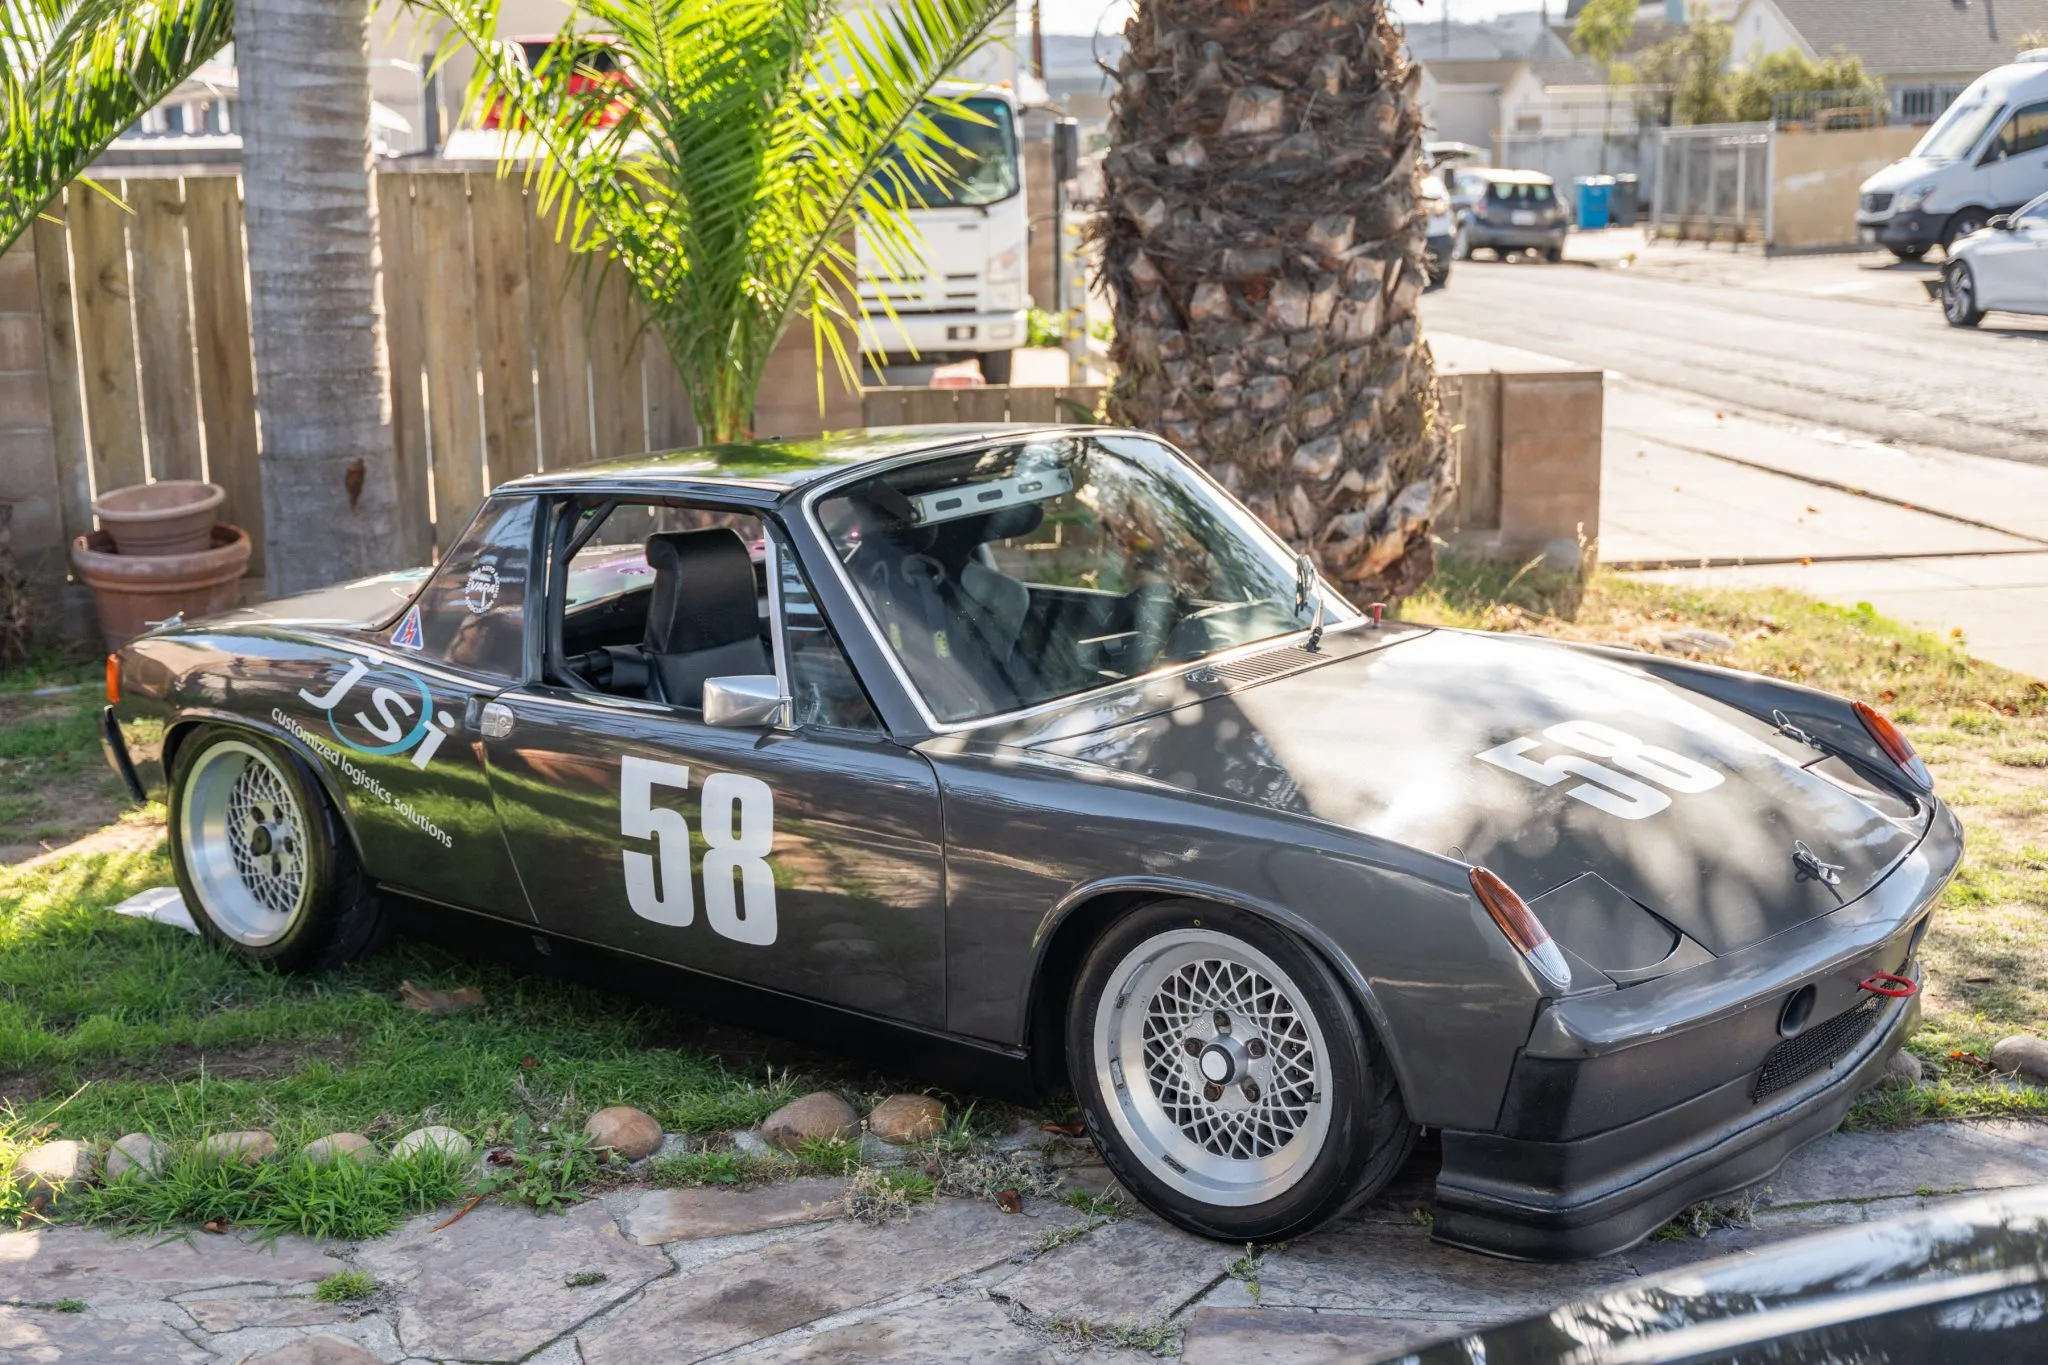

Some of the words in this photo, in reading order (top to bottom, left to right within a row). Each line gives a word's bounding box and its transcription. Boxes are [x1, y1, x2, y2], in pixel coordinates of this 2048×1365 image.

[470, 580, 496, 593] VARA
[271, 707, 340, 766] customized
[340, 755, 392, 804] logistics
[393, 798, 452, 848] solutions
[1473, 720, 1725, 820] 58
[620, 755, 778, 946] 58
